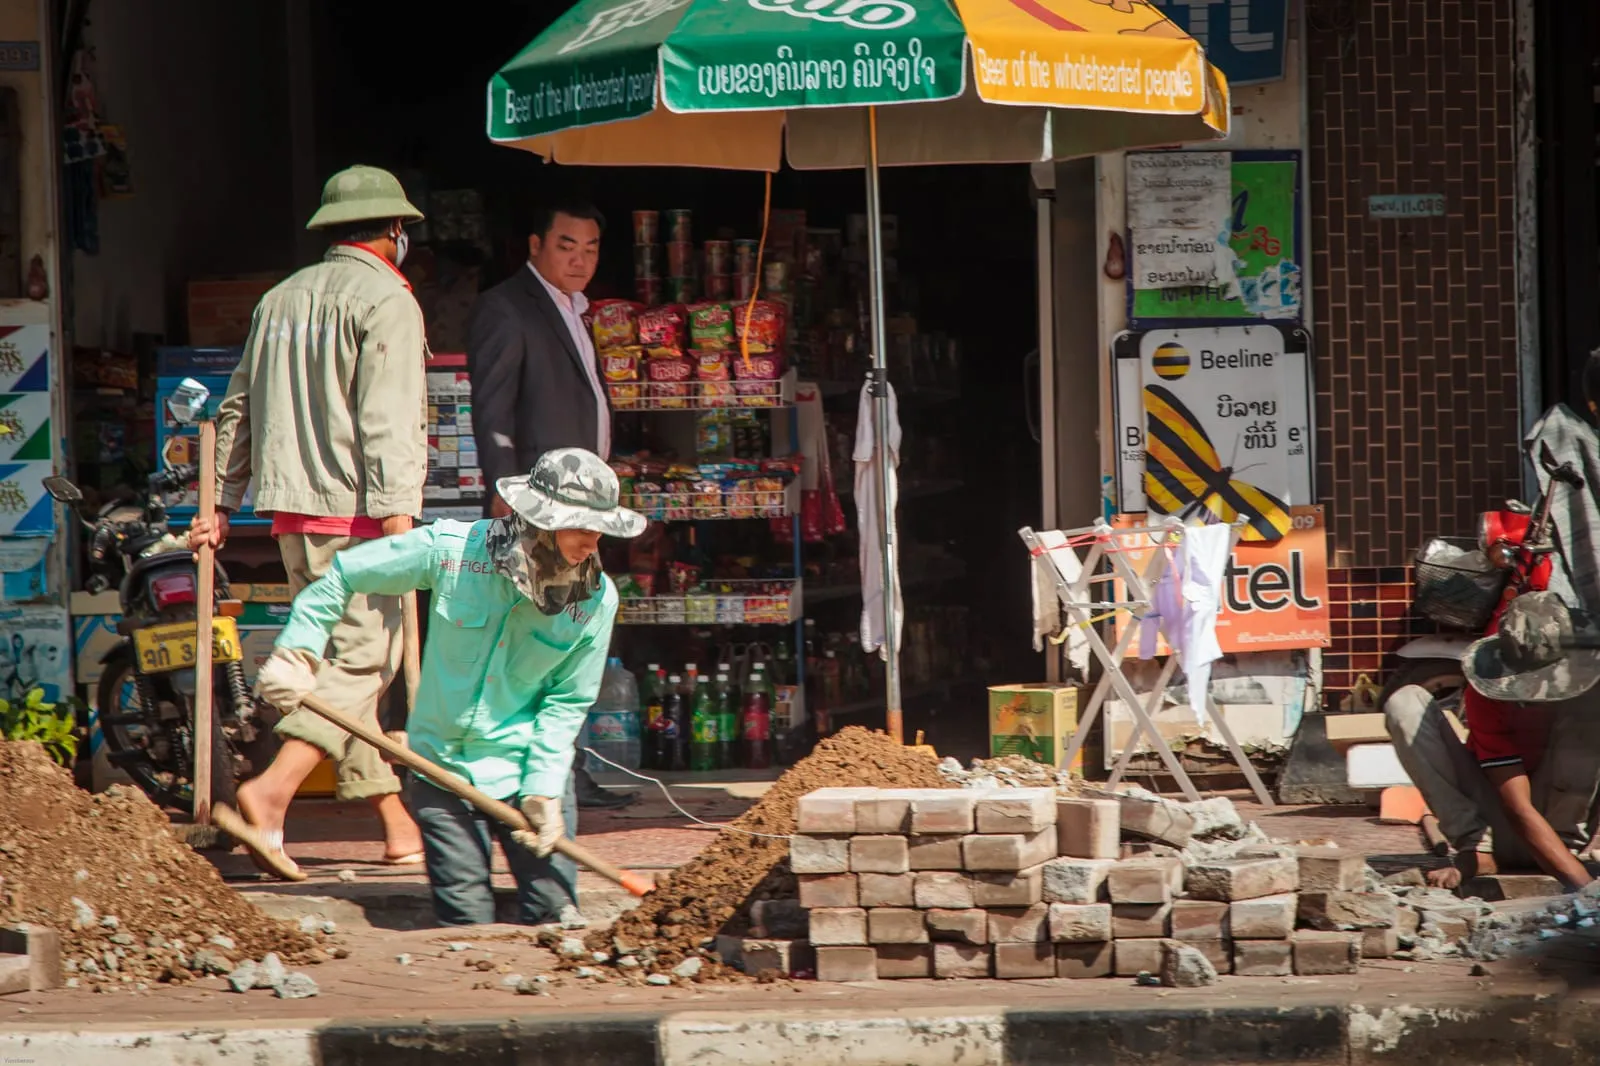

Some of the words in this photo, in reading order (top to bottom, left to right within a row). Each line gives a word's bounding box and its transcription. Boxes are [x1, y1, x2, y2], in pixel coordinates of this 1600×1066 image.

[1156, 0, 1275, 52] TL
[505, 88, 531, 124] Beer
[534, 82, 545, 119] of
[546, 80, 562, 117] the
[562, 67, 625, 113] wholehearted
[978, 47, 1008, 86] Beer
[1012, 50, 1026, 88] of
[1028, 51, 1049, 88] the
[1053, 53, 1142, 95] wholehearted
[1144, 60, 1193, 106] people
[1253, 226, 1281, 256] 3G
[1200, 349, 1274, 370] Beeline
[1216, 394, 1277, 418] ບີລາຍ
[1243, 420, 1277, 450] ທີ່ນີ້
[1216, 549, 1323, 615] tel
